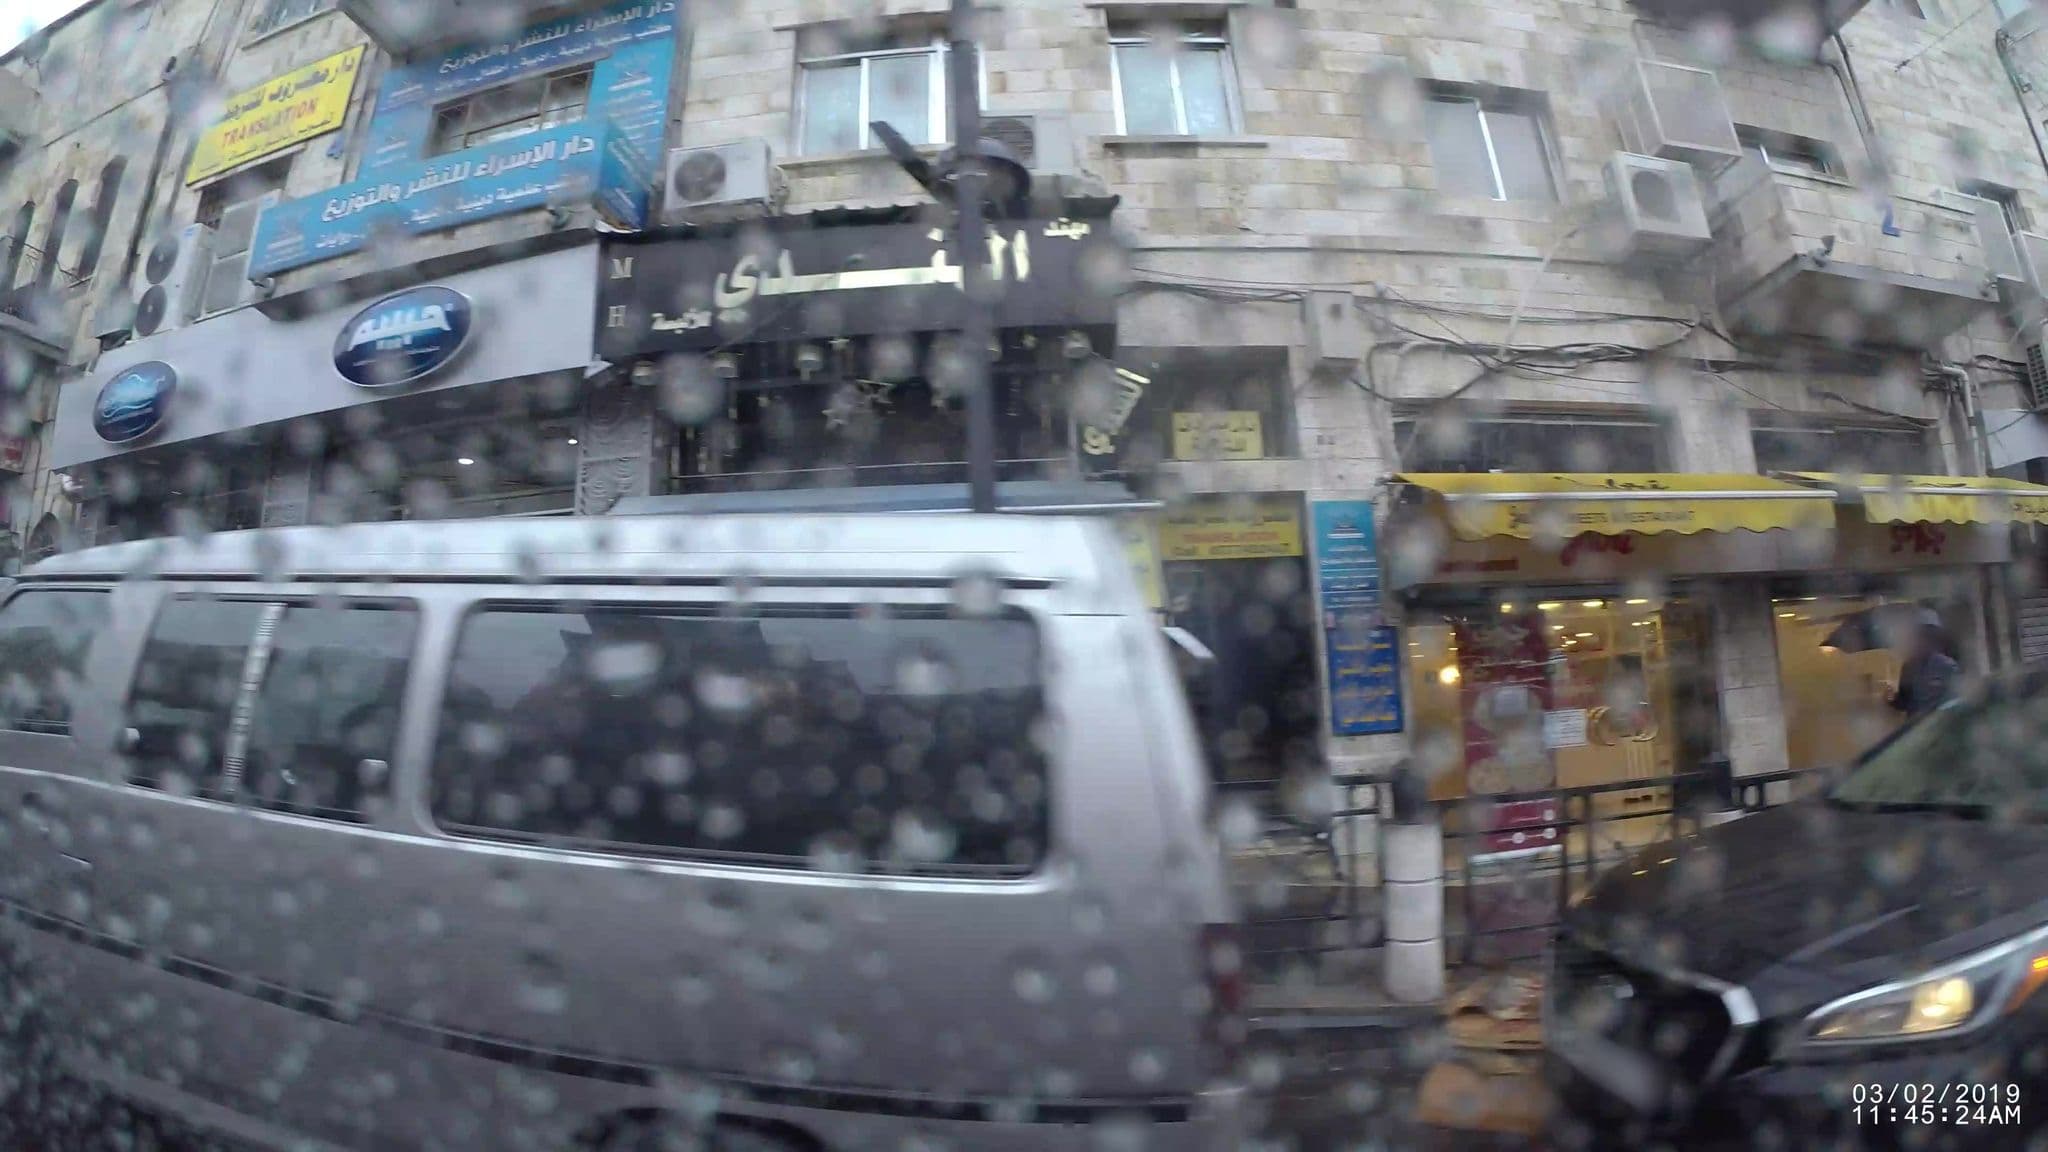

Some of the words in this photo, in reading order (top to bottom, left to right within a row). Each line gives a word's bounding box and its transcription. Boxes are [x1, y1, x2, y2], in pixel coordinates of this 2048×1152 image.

[474, 140, 555, 178] الإسراء
[560, 134, 595, 162] دار
[403, 160, 472, 199] للنشر
[320, 182, 402, 223] والتوزيع
[610, 257, 634, 280] M
[606, 304, 627, 328] H
